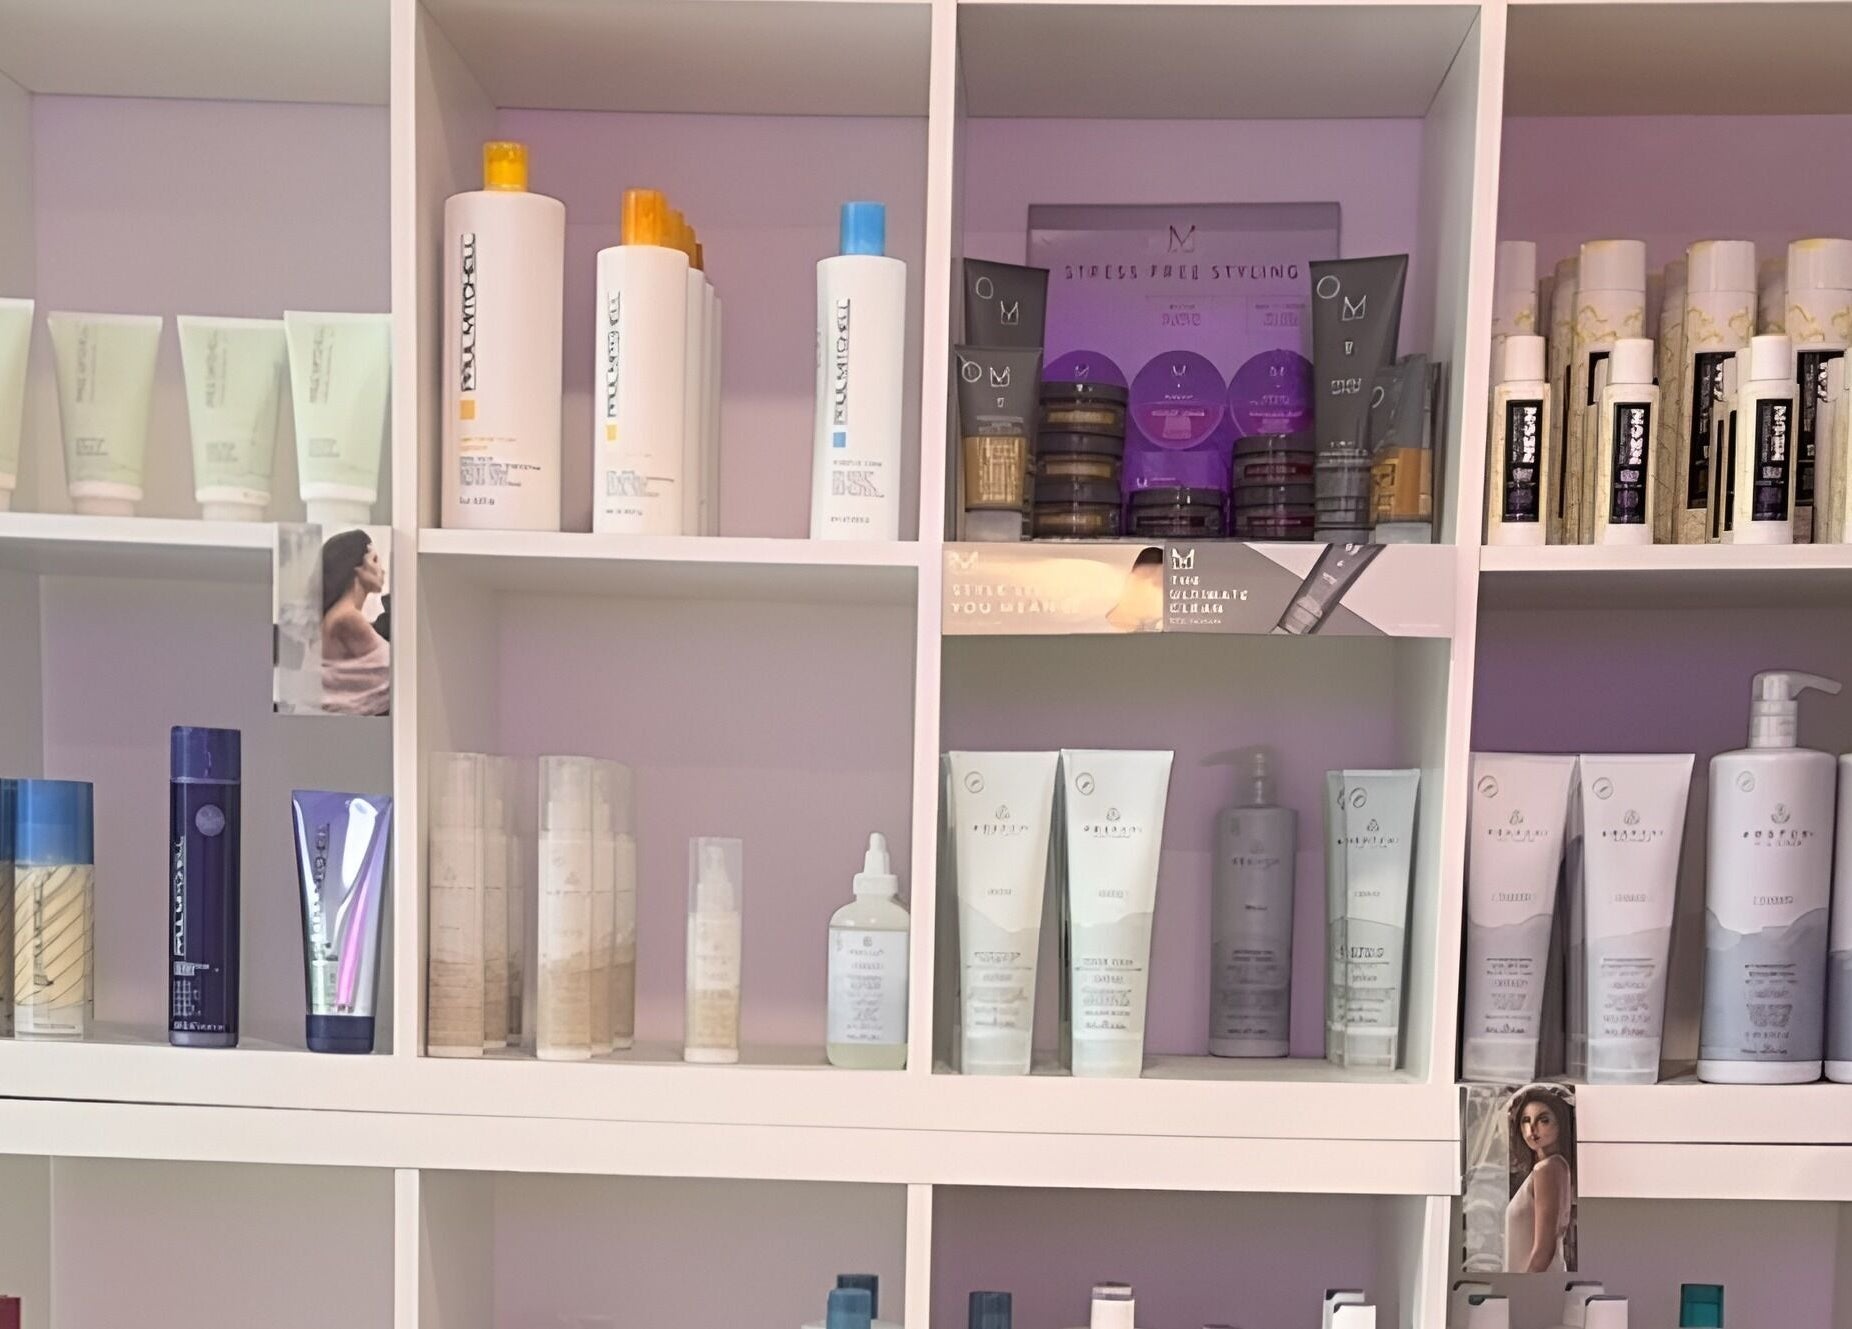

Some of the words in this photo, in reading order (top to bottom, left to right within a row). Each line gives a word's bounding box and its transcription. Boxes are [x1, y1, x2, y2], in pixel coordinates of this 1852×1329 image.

[1065, 264, 1138, 280] STRESS
[1150, 264, 1199, 280] FREE
[1211, 263, 1299, 280] STYLING
[952, 601, 992, 615] YOU
